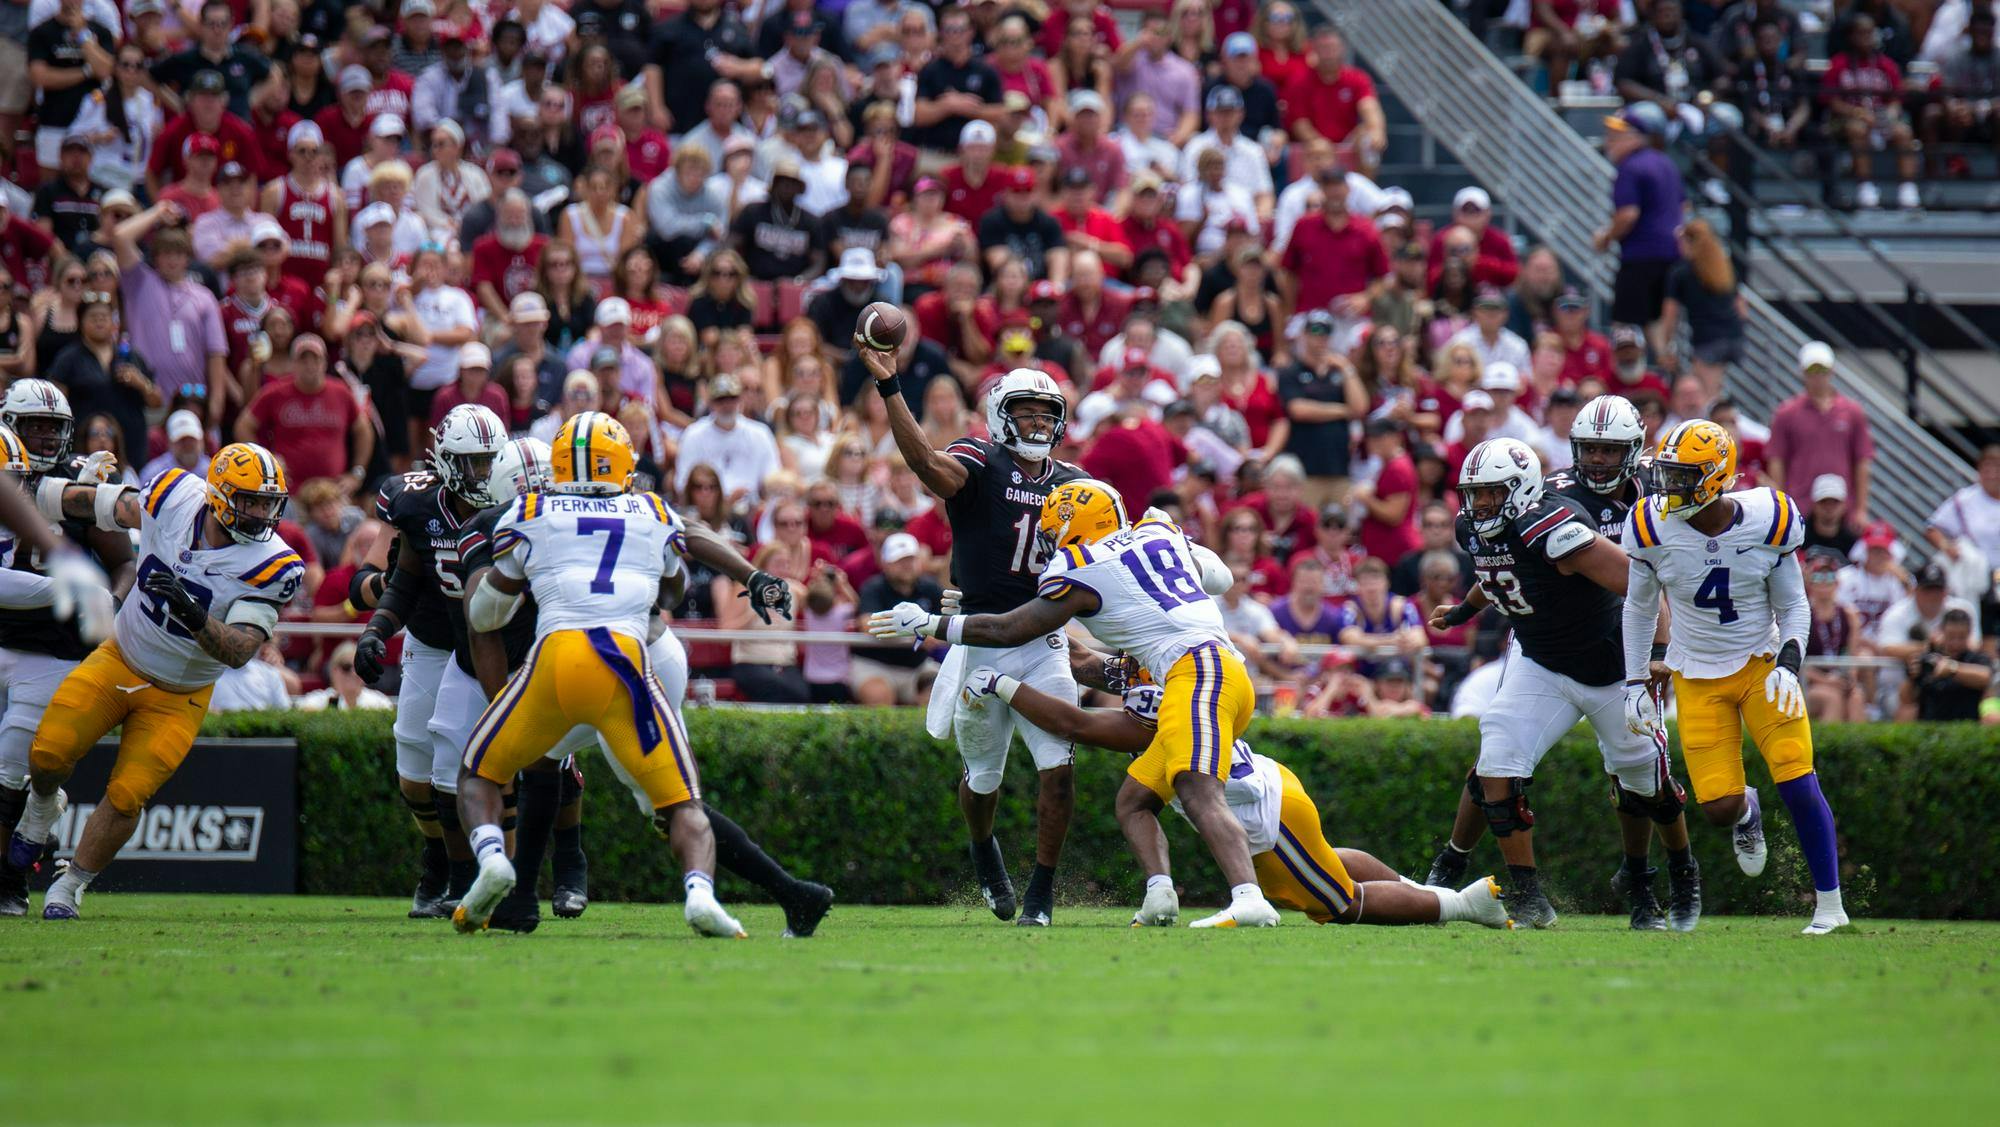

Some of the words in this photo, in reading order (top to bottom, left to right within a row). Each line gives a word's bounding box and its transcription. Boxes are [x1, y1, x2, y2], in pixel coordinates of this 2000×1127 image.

[551, 499, 618, 513] PERKINS
[624, 499, 647, 515] JR.
[172, 562, 188, 576] LSU
[434, 550, 465, 599] 5
[576, 517, 626, 595] 7
[1120, 539, 1208, 613] 18
[1473, 553, 1516, 568] GAMECOCKS
[1704, 558, 1723, 566] LSU
[1475, 571, 1535, 616] 53
[1693, 567, 1740, 625] 4
